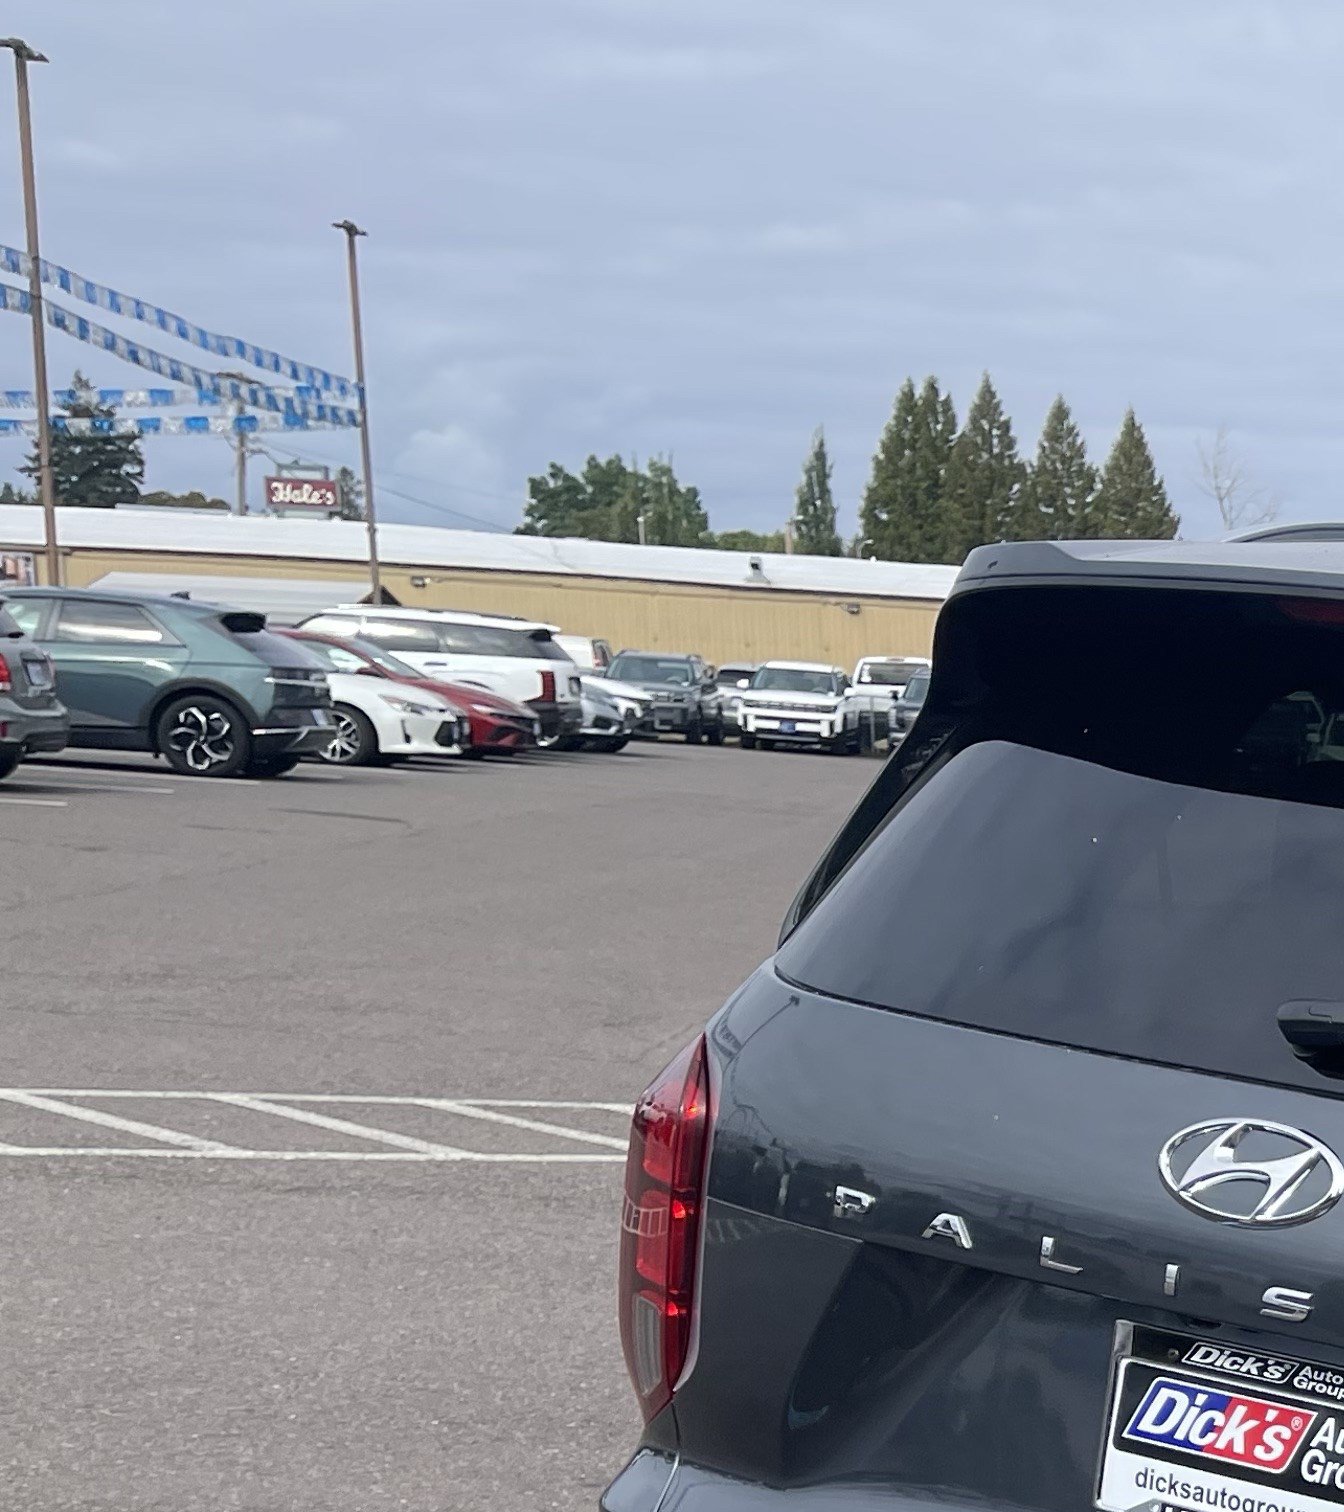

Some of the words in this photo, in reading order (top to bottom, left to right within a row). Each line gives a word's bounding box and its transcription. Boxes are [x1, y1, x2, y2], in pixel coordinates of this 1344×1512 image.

[270, 481, 335, 505] Hale's
[1190, 1345, 1286, 1380] Dick's
[1298, 1365, 1344, 1385] Auto
[1136, 1387, 1292, 1462] Dick's
